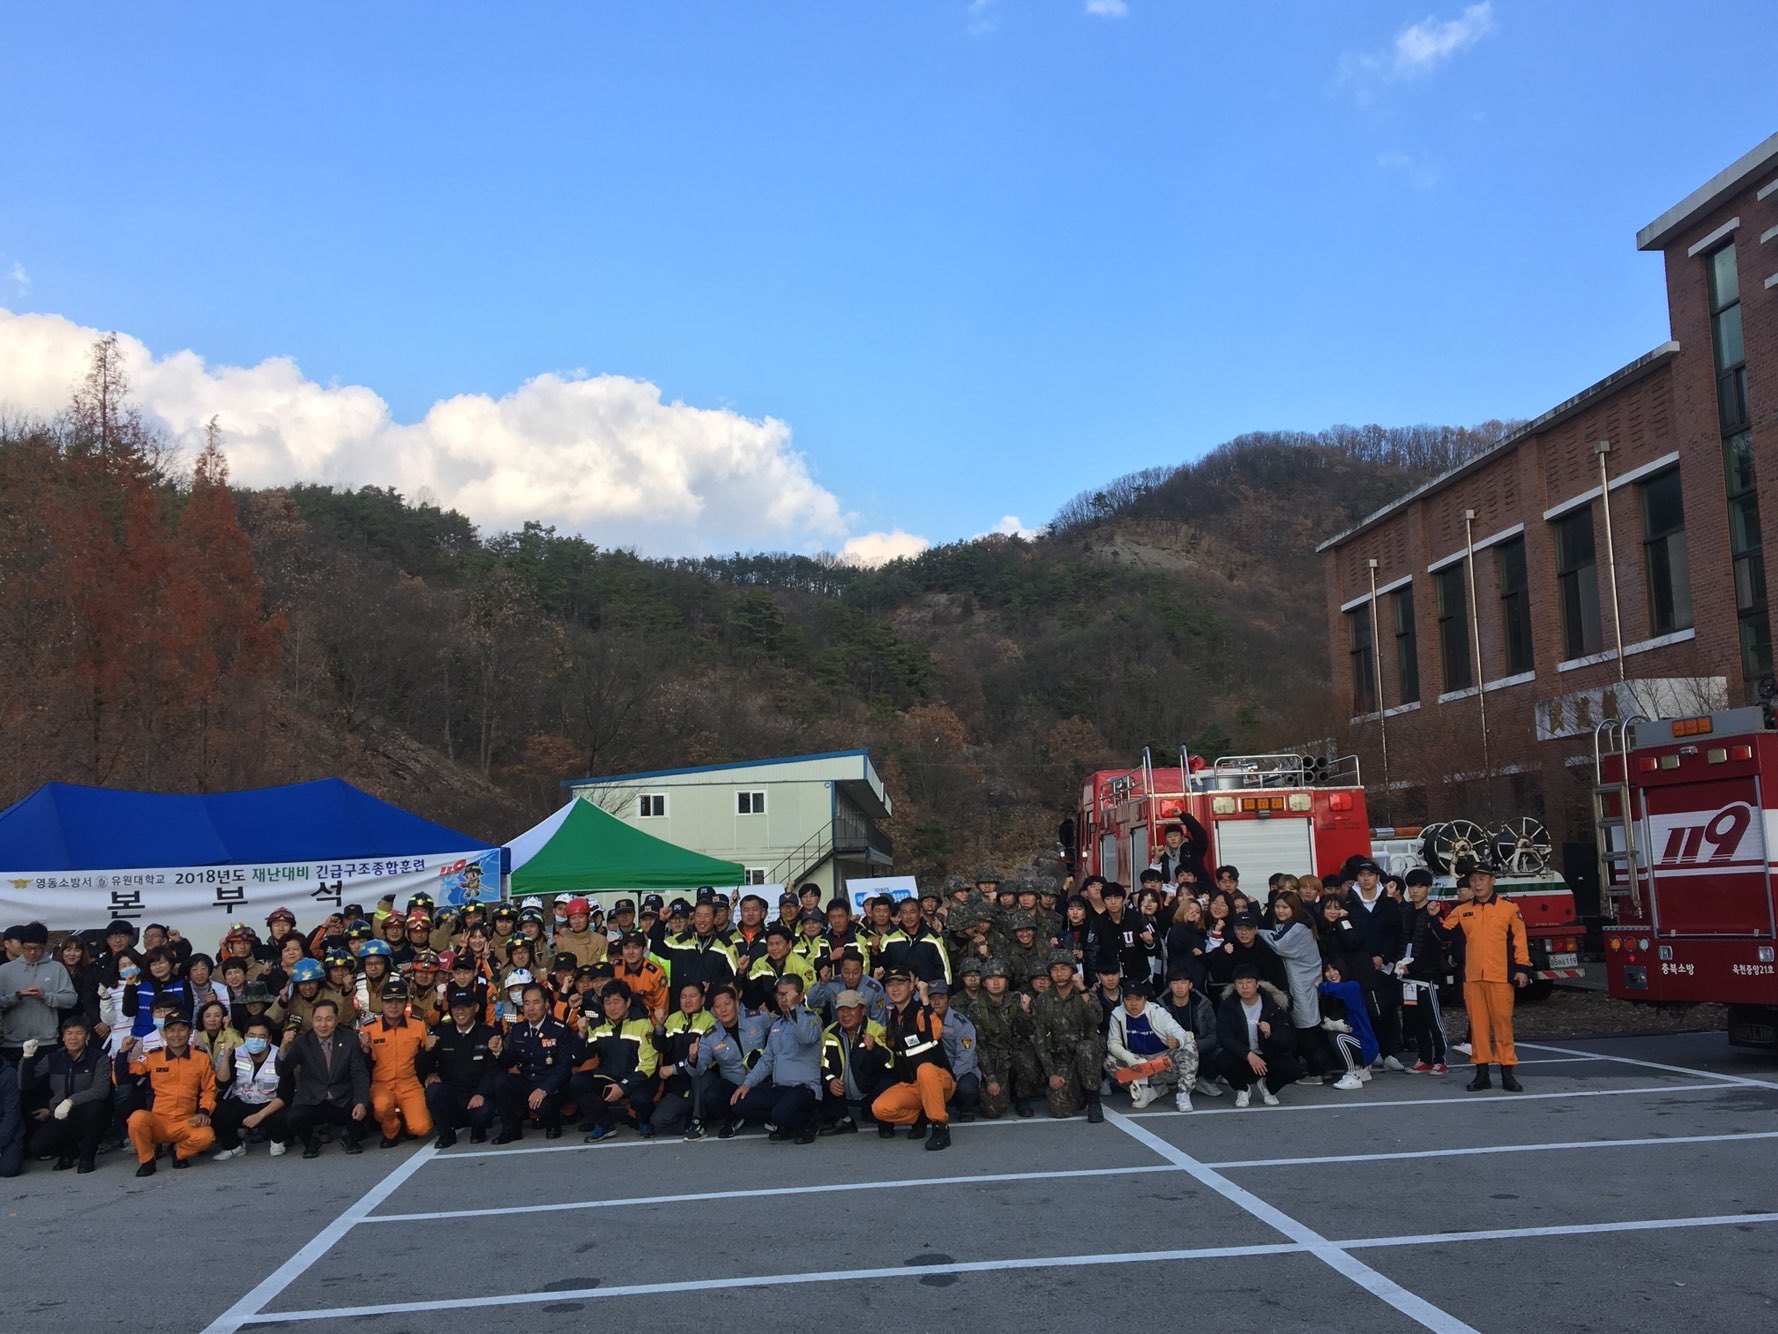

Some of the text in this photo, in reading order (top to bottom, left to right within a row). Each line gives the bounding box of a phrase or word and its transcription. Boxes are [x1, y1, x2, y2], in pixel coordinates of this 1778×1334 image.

[1661, 801, 1752, 864] 119
[35, 858, 425, 889] 영동소방서 유원대학교 2018년도 재난대비 긴급구조종합훈련
[107, 880, 342, 919] 본 부 석
[1661, 963, 1694, 975] 충북소방
